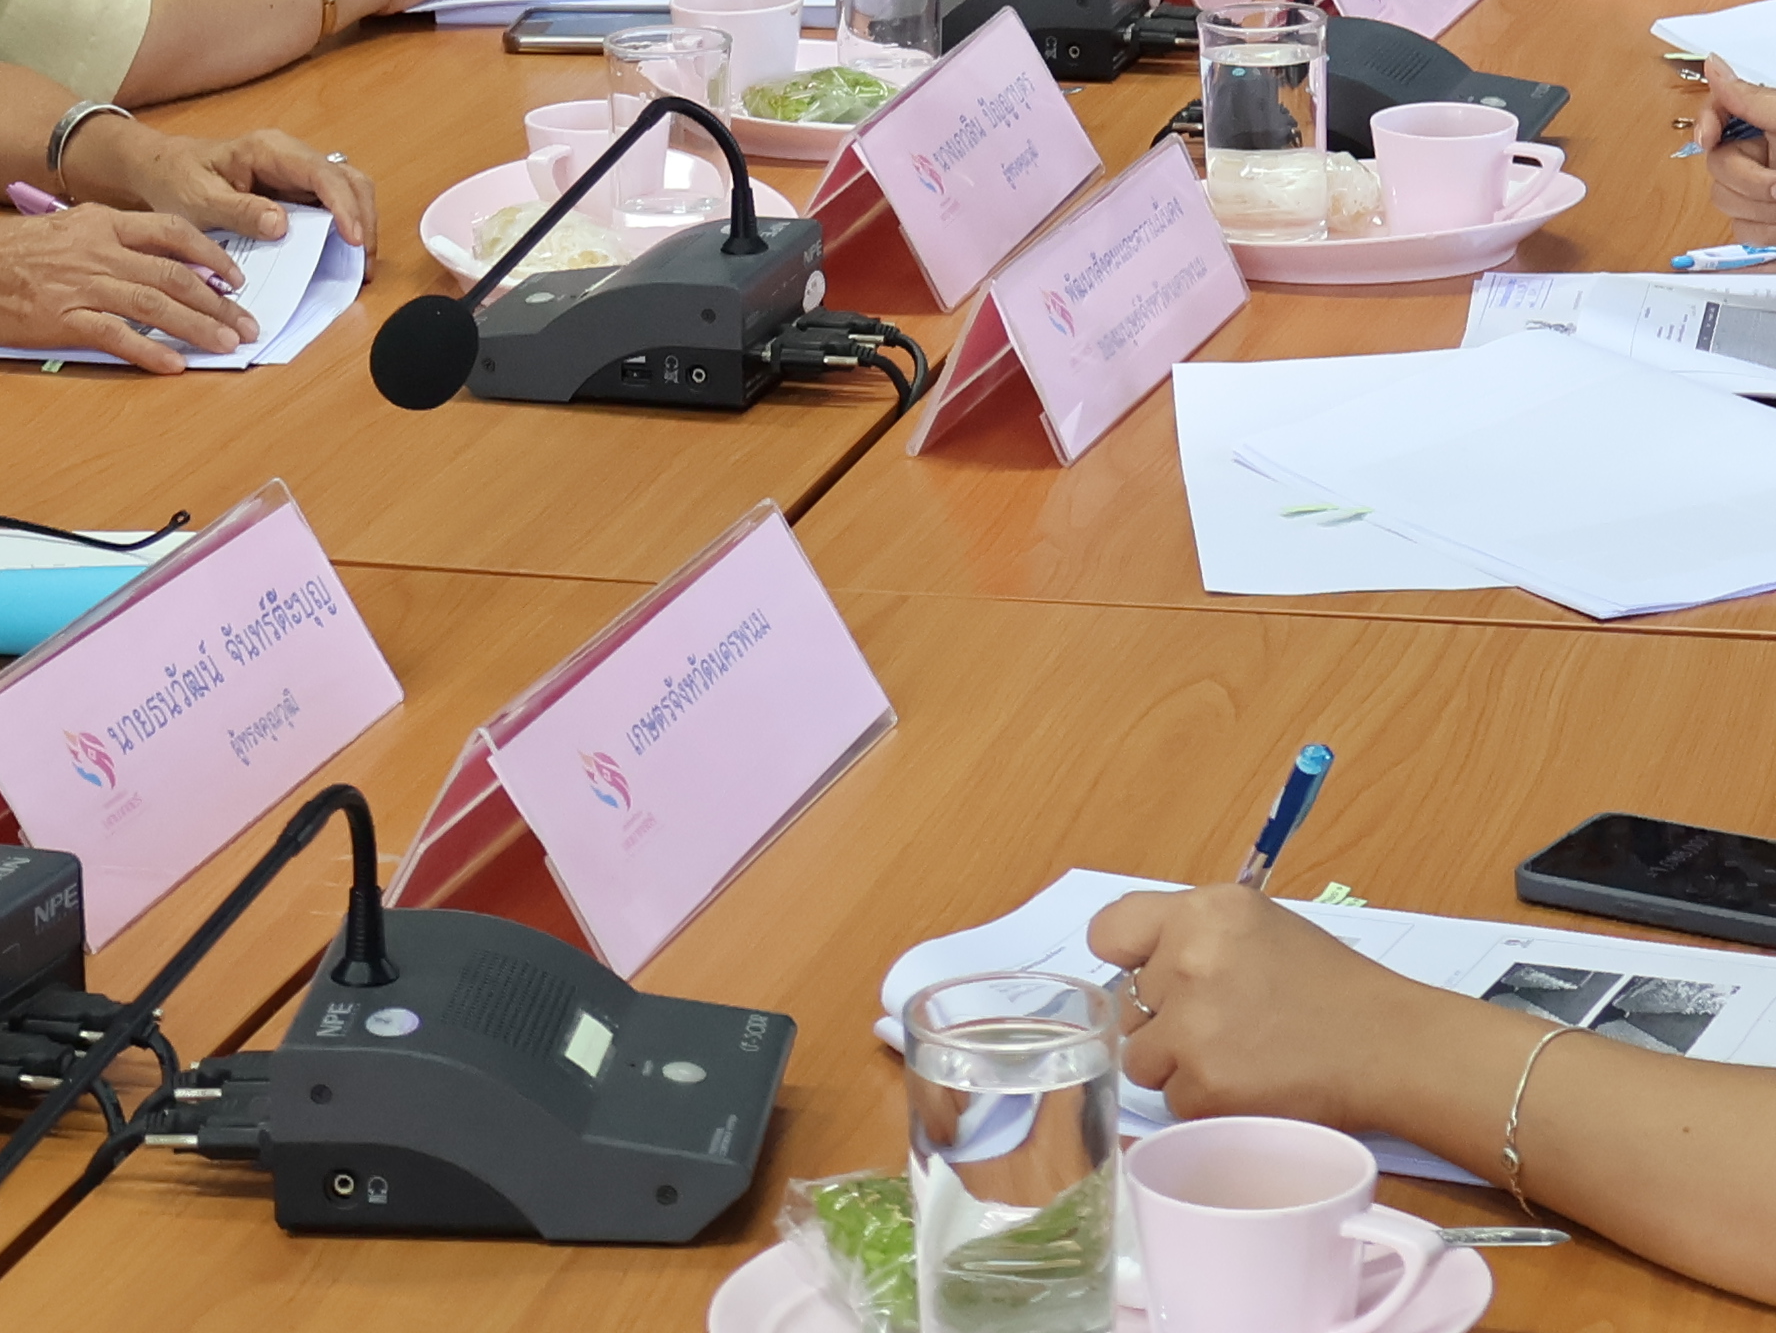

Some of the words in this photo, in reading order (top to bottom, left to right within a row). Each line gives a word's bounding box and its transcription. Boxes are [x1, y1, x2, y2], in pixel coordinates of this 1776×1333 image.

[107, 645, 225, 756] นายธนวัฒน์
[626, 608, 772, 756] เกษตรจังหวัดนครพนม
[229, 688, 302, 767] ผู้ทรงคุณวุฒิ
[34, 882, 79, 927] NPE
[316, 1002, 354, 1037] NPE
